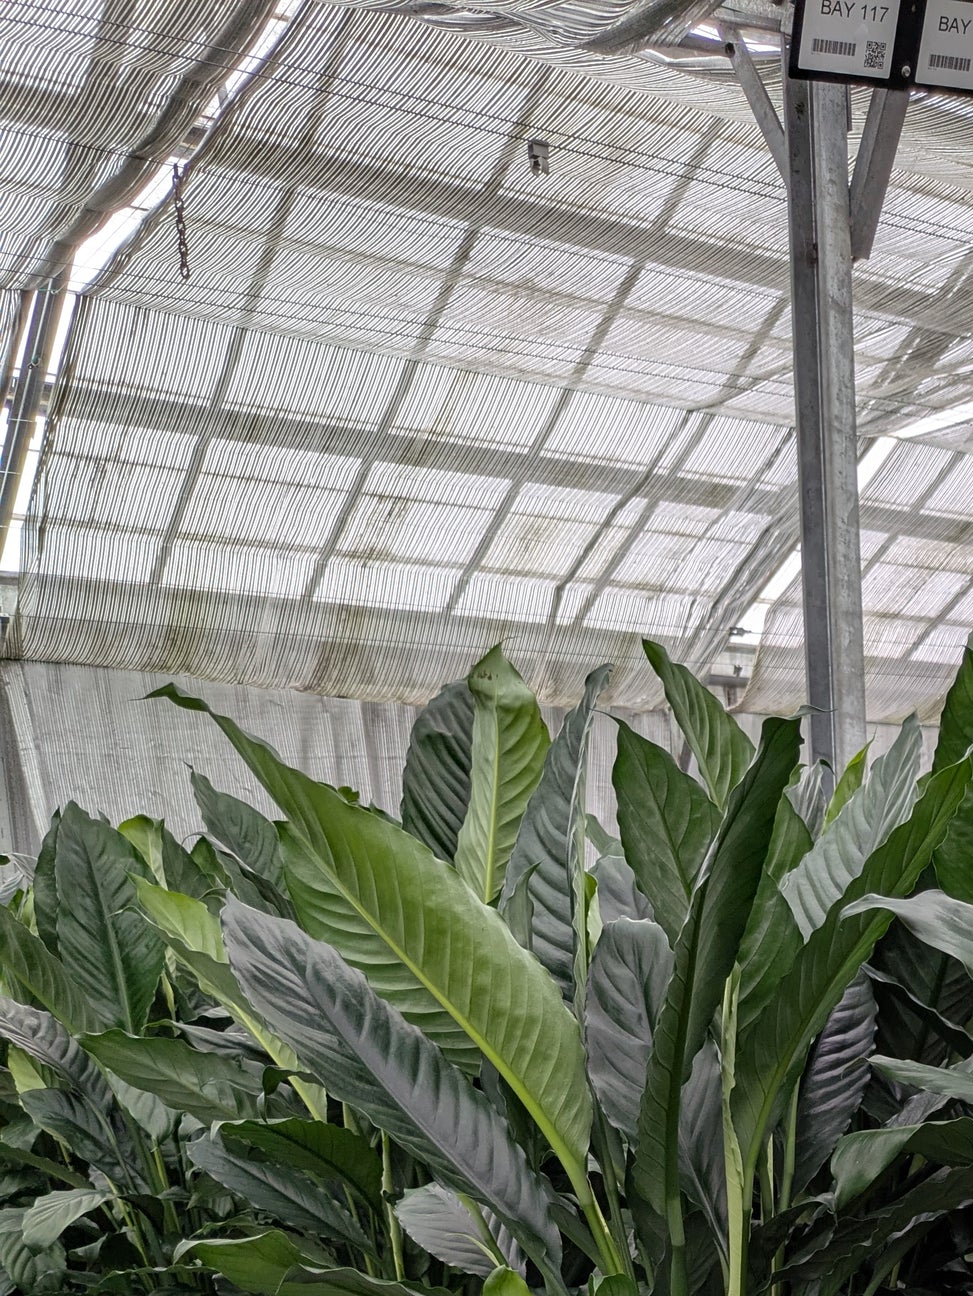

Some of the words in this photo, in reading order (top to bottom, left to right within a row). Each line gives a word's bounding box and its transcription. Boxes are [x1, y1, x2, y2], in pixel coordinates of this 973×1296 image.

[820, 0, 856, 18] BAY
[861, 4, 890, 22] 117
[938, 15, 972, 35] BAY
